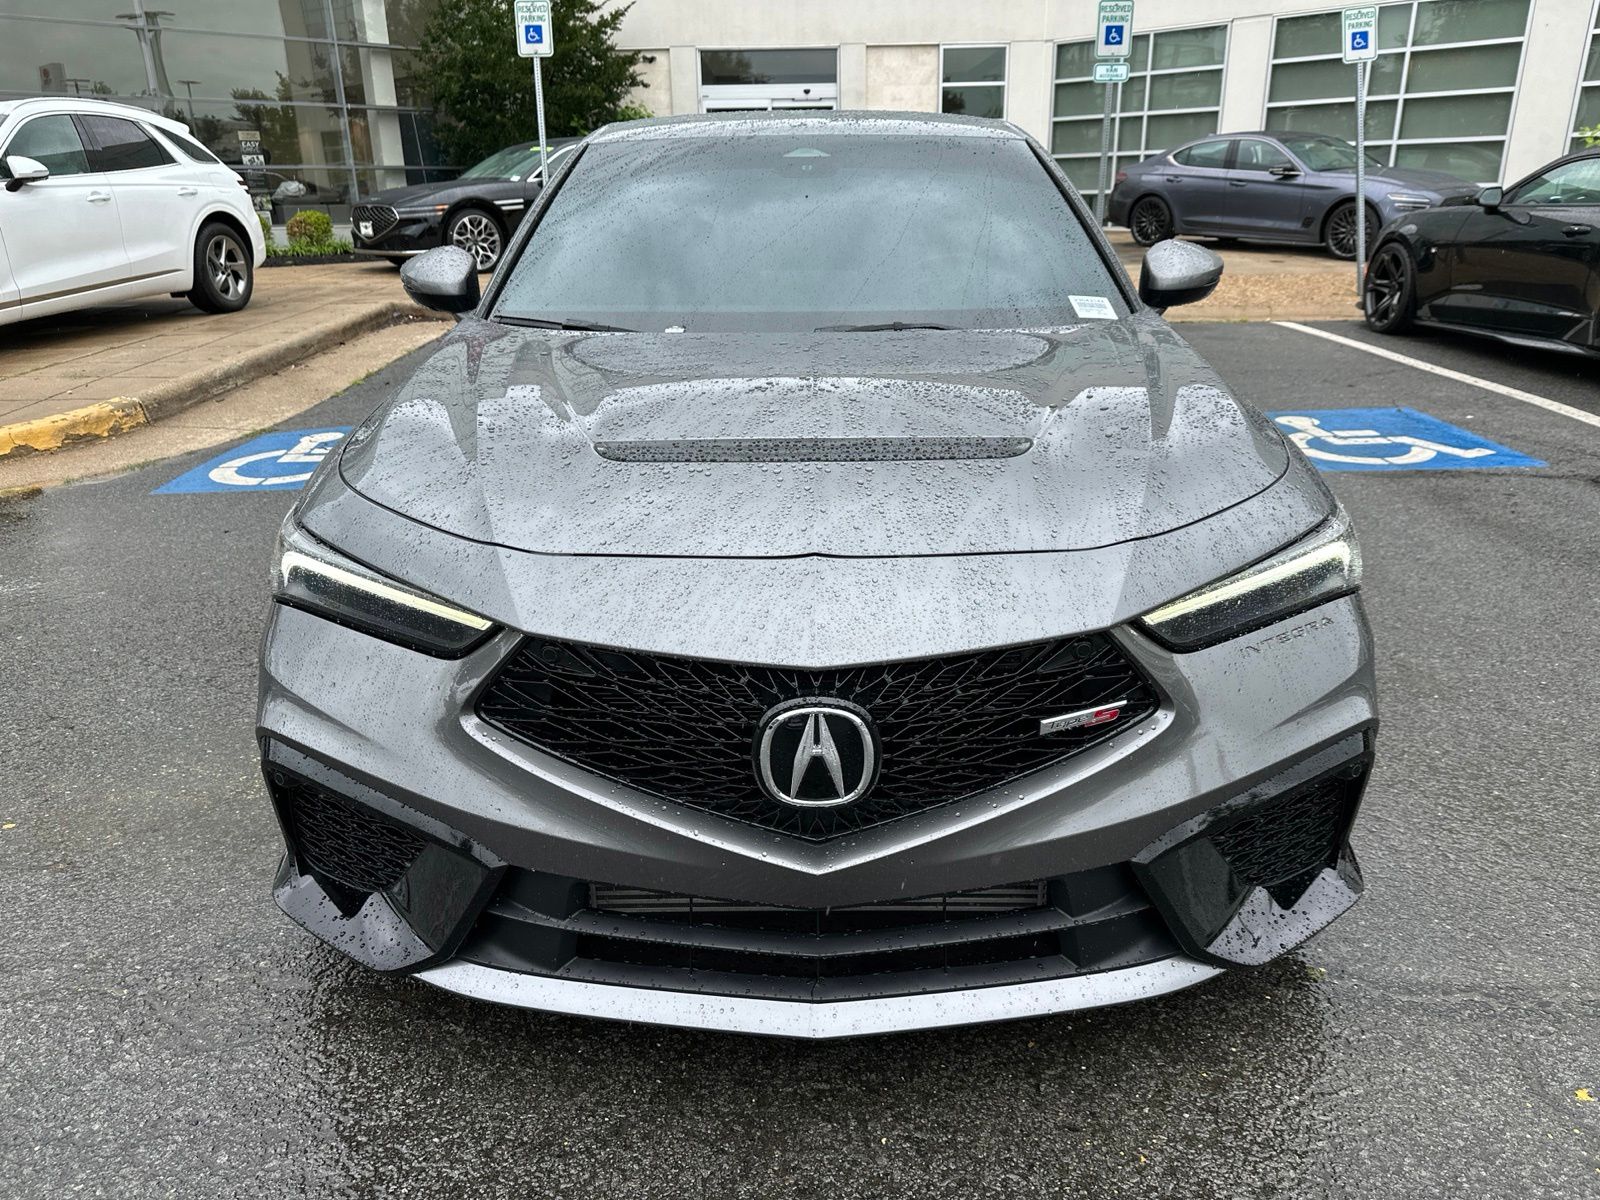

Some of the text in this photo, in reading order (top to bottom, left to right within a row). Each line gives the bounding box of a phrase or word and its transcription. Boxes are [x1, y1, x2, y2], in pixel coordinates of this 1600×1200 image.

[517, 5, 547, 13] RESERVED
[520, 15, 546, 23] PARKING
[1102, 15, 1129, 23] PARKING
[1346, 11, 1375, 20] RESERVED
[1348, 20, 1373, 30] PARKING
[1240, 617, 1335, 659] INTEGRA
